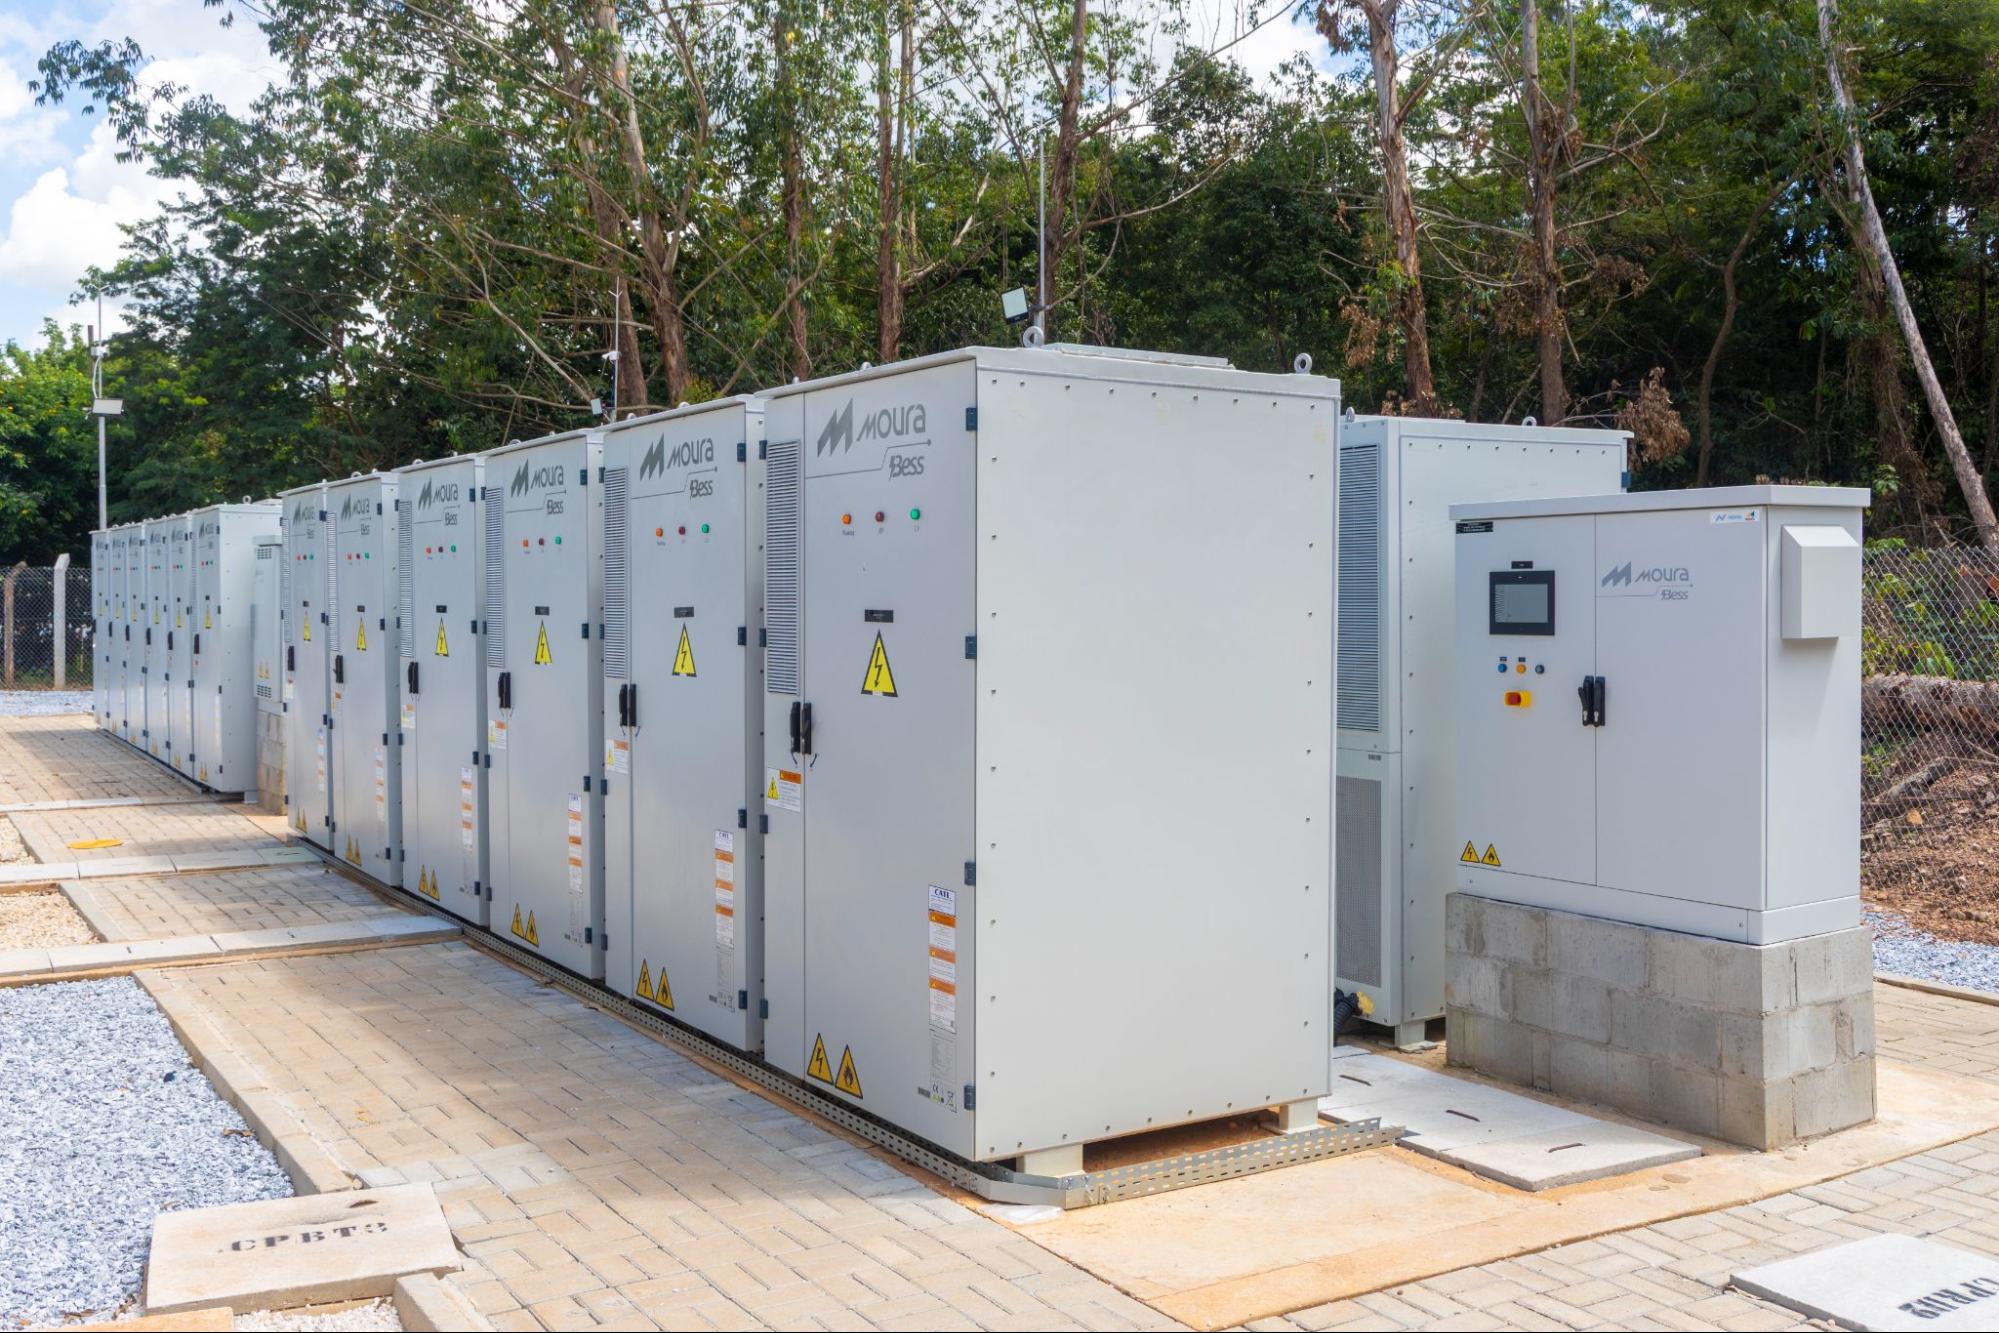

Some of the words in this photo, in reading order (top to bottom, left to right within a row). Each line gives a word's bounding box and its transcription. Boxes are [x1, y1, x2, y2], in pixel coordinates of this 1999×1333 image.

[856, 404, 926, 442] Moura
[666, 438, 714, 469] Moura
[530, 465, 564, 488] Moura
[888, 455, 925, 480] Bess
[689, 479, 713, 500] Bess
[1634, 567, 1690, 583] Moura
